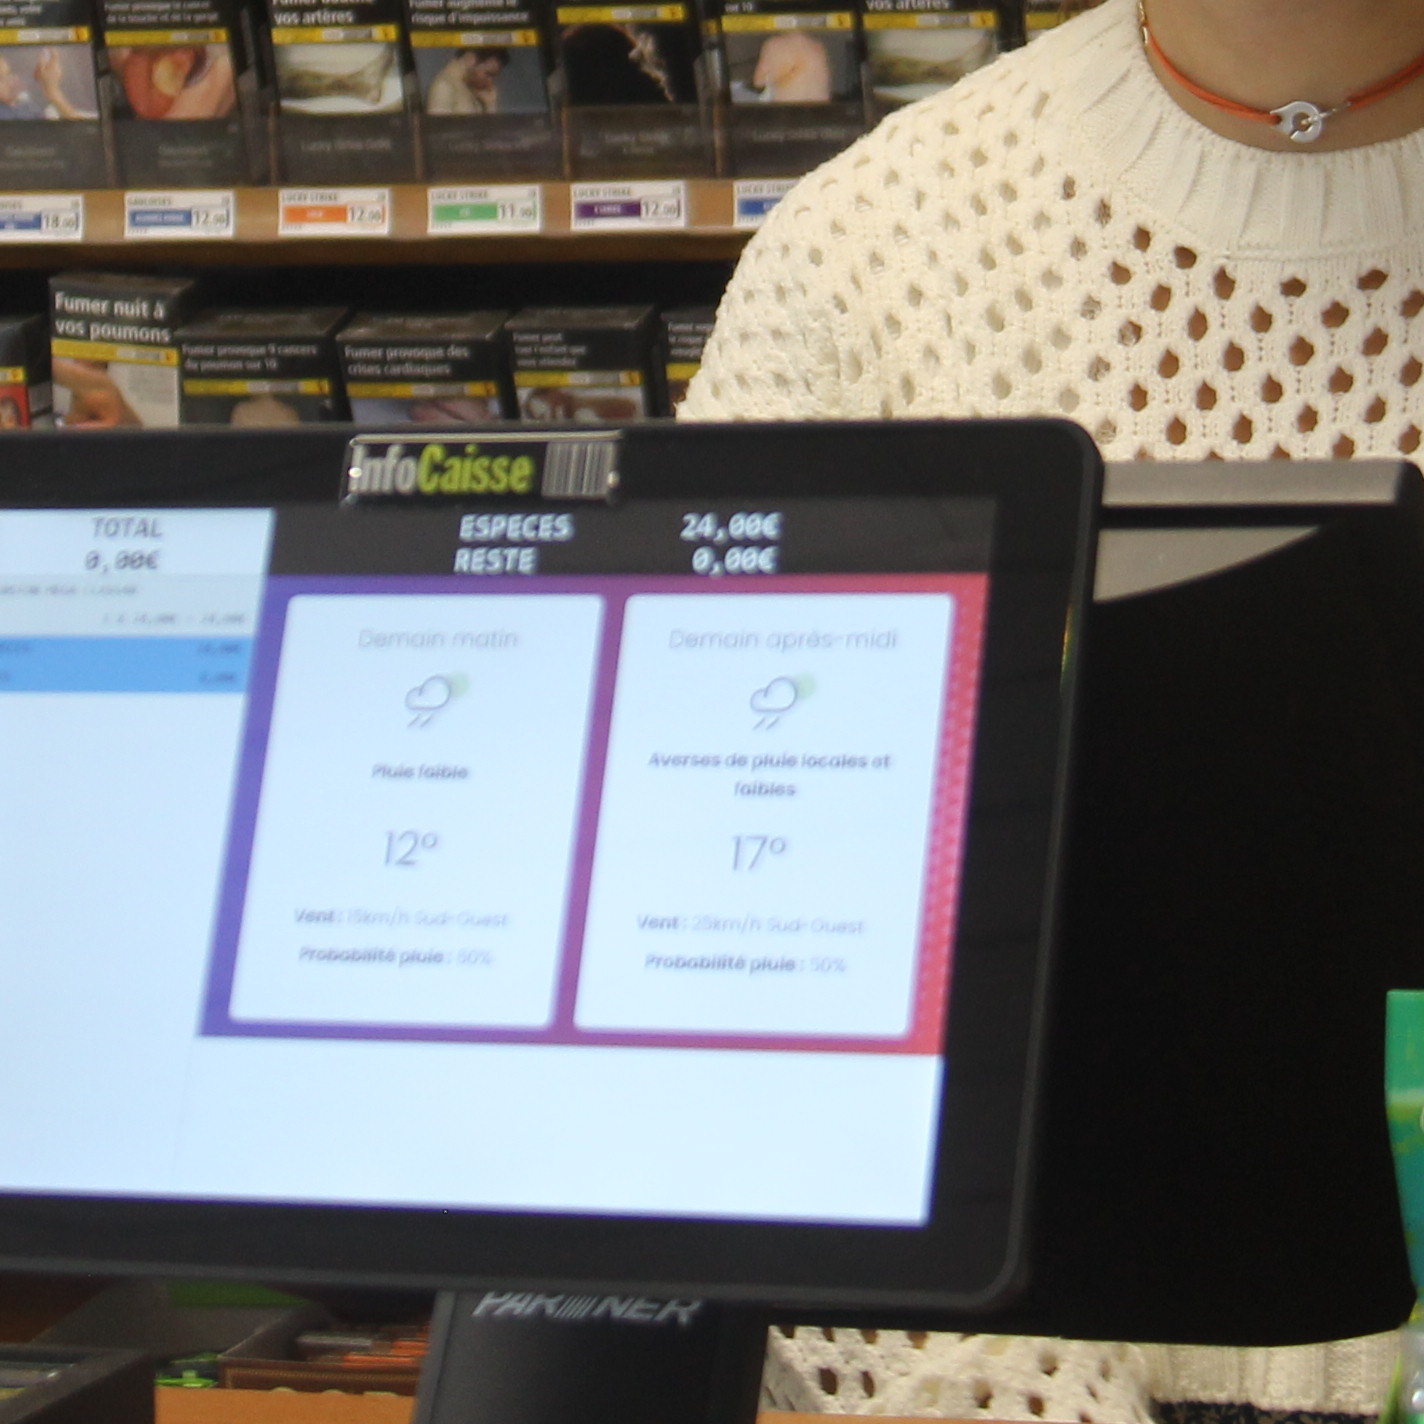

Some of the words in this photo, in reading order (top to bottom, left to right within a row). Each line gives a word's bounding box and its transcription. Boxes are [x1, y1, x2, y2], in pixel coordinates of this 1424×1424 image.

[273, 11, 299, 25] vos
[303, 8, 354, 25] artères
[54, 291, 110, 317] Fumer
[113, 297, 149, 318] nuit
[152, 296, 165, 319] à
[55, 319, 86, 337] vos
[90, 320, 171, 344] poumons
[348, 443, 535, 496] InfoCaisse
[92, 517, 163, 540] TOTAL
[459, 515, 574, 542] ESPECES
[680, 512, 782, 543] 24,00€
[85, 549, 161, 575] 0,00€
[453, 548, 538, 574] RESTE
[692, 545, 778, 576] 0,00€
[357, 628, 447, 650] Demain
[450, 628, 519, 649] matin
[668, 629, 761, 651] Demain
[765, 629, 899, 655] après-midi
[371, 763, 414, 780] Pluie
[417, 763, 469, 780] faible
[648, 751, 721, 769] Averses
[725, 752, 748, 768] de
[751, 751, 797, 773] pluie
[801, 751, 868, 769] locales
[871, 751, 891, 768] et
[733, 780, 797, 799] faibles
[383, 829, 439, 867] 12°
[731, 834, 788, 872] 17°
[767, 916, 865, 935] Sud-Ouest
[644, 953, 746, 973] Probabilité
